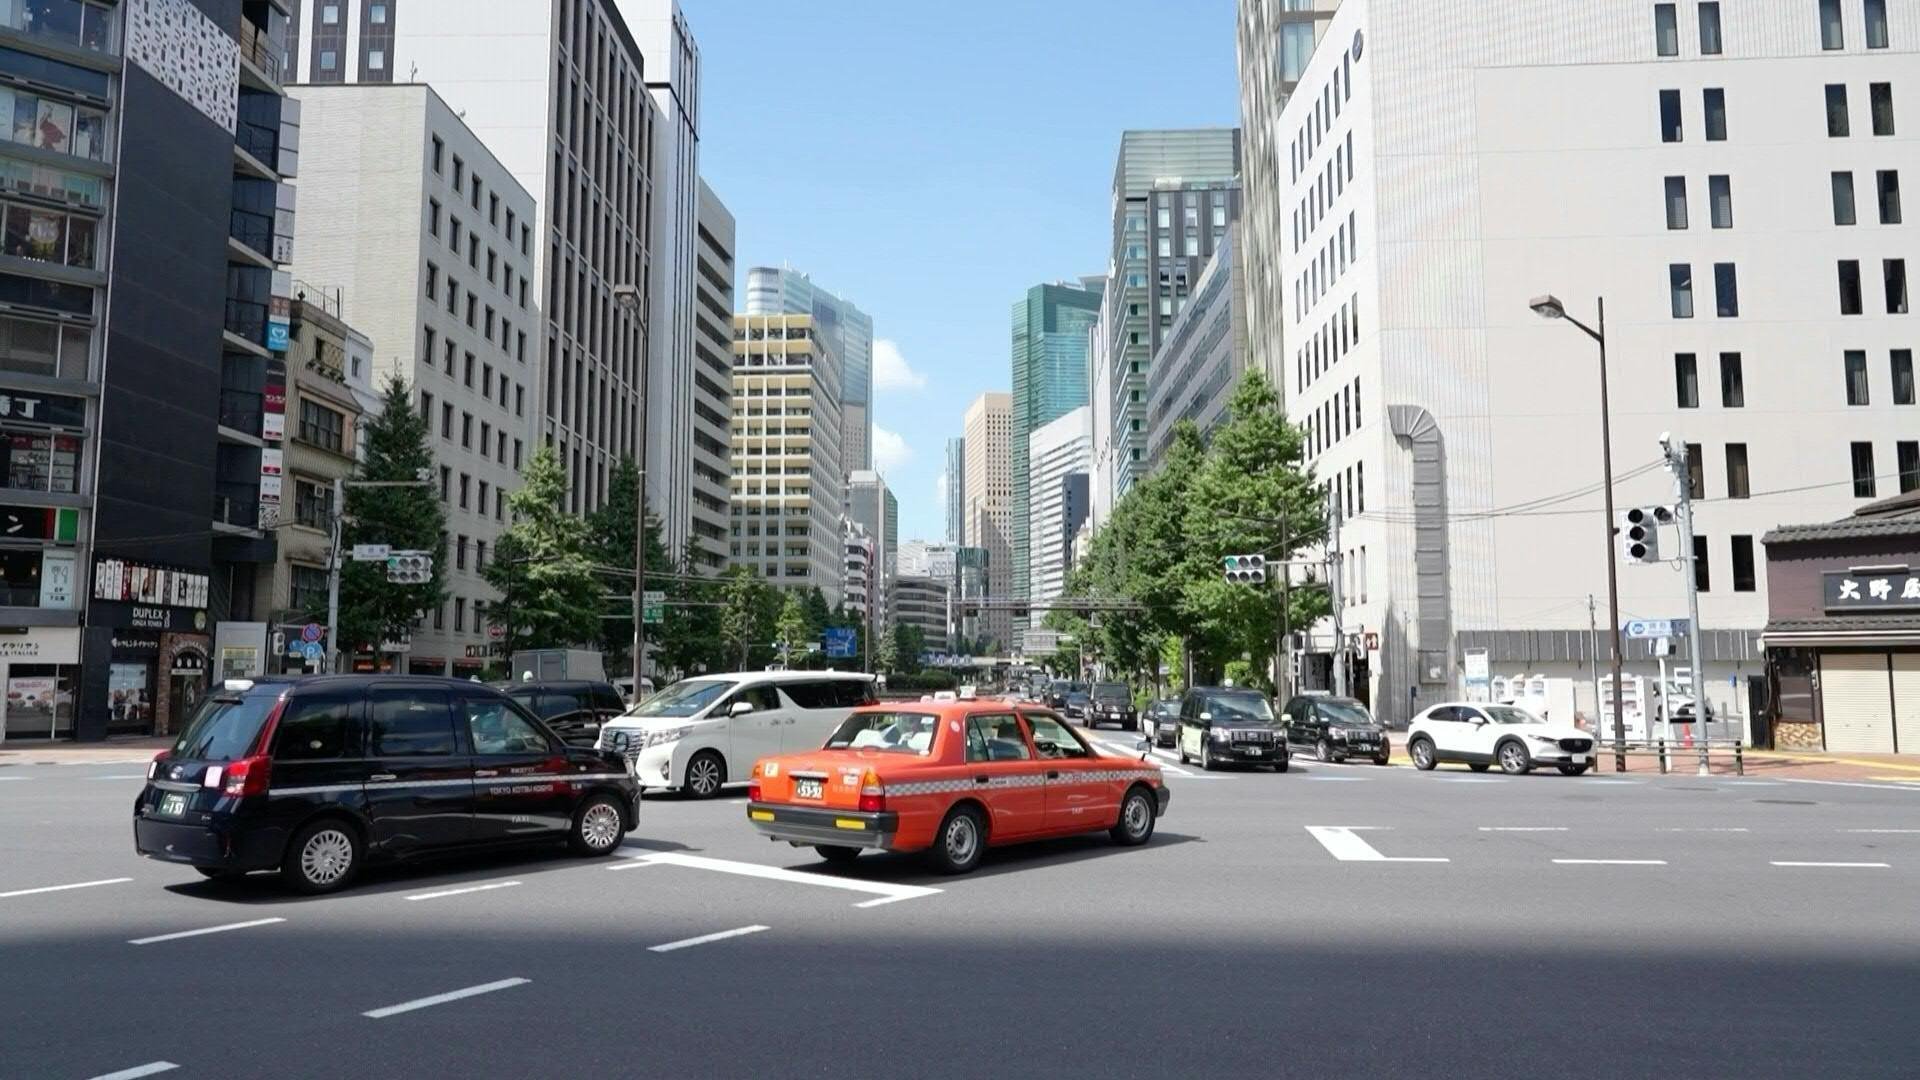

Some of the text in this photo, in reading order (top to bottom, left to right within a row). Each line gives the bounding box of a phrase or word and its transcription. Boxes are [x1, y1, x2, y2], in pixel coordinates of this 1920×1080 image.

[1838, 577, 1920, 601] 大野屋
[133, 608, 163, 619] DUPLEX
